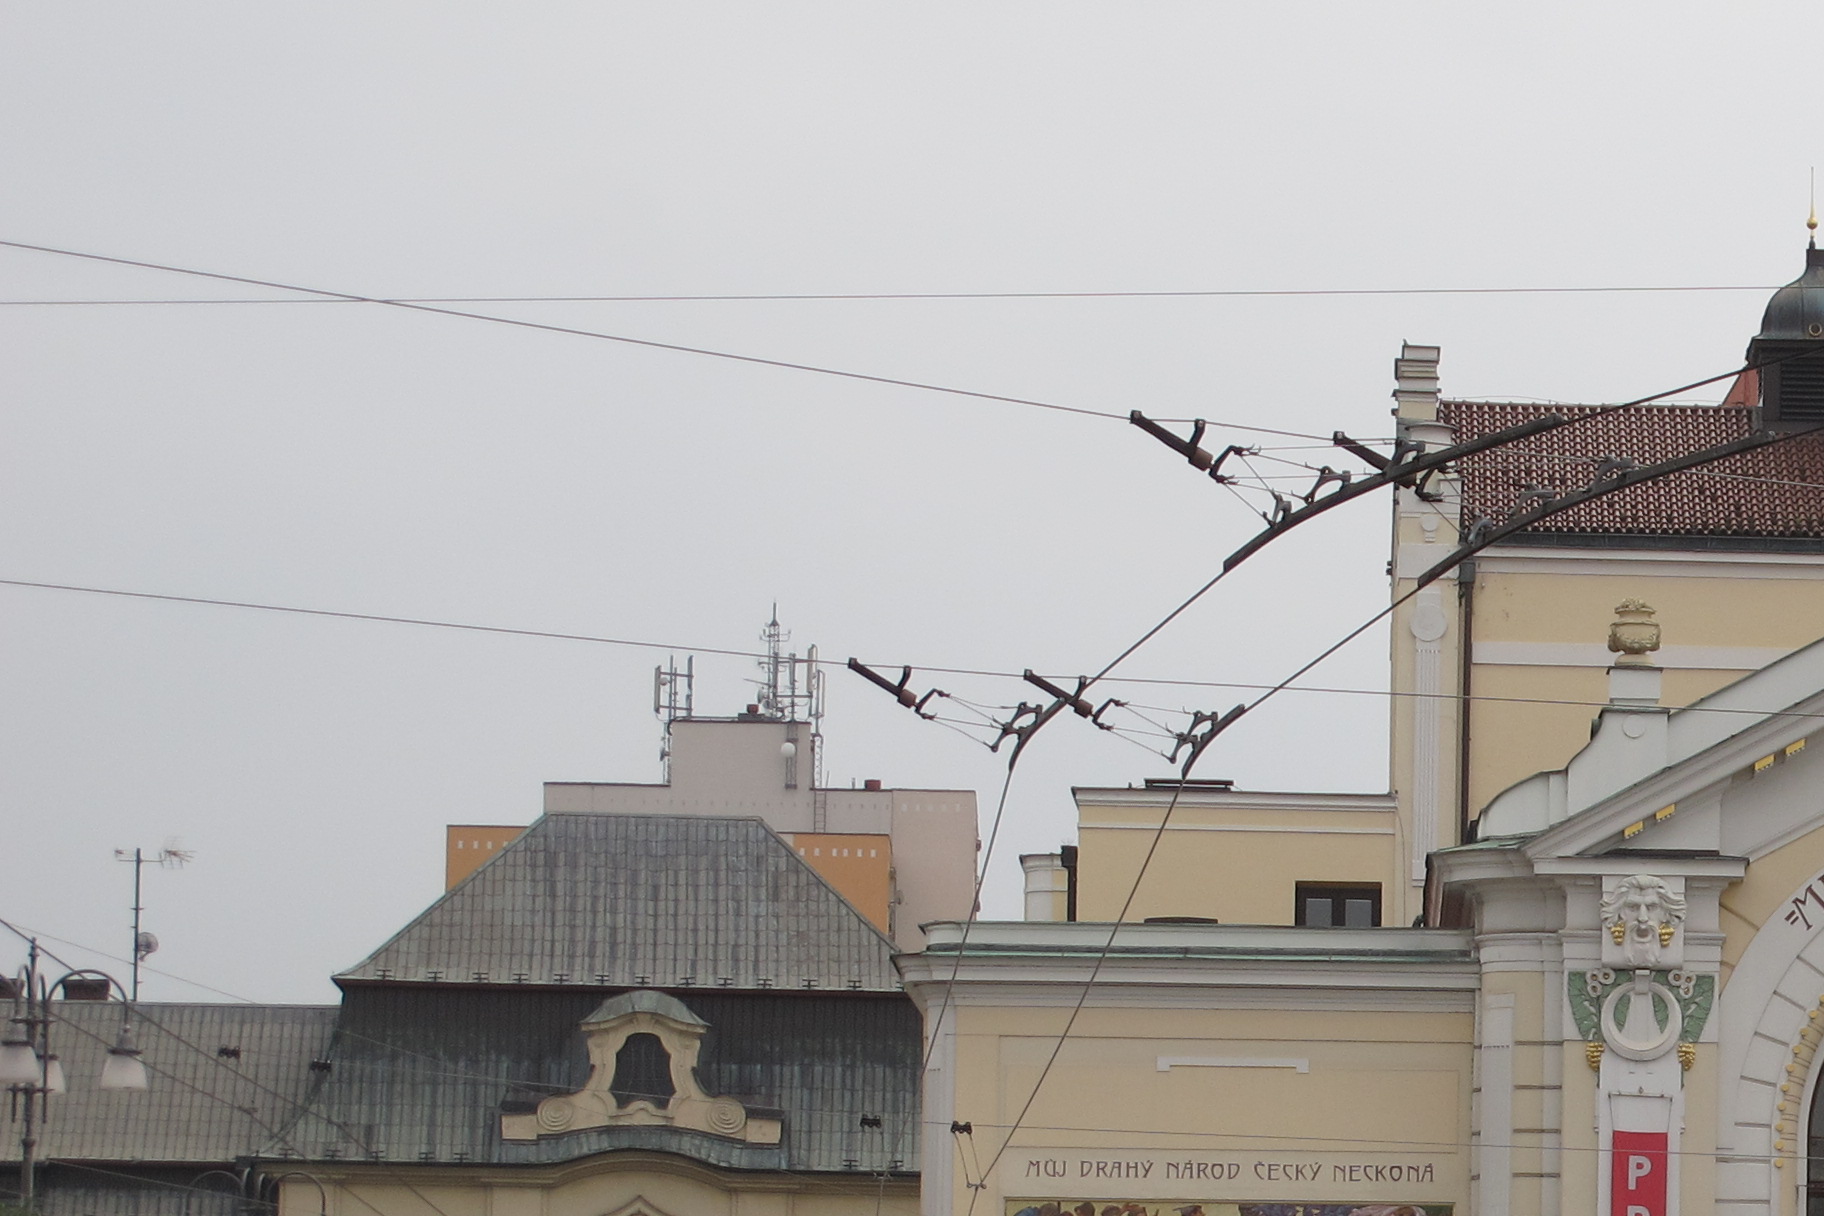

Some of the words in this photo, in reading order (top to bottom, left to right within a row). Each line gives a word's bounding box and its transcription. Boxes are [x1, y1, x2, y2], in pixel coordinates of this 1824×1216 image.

[1025, 1158, 1067, 1178] MŮJ
[1080, 1159, 1154, 1180] DRAHÝ
[1166, 1159, 1241, 1180] NÁROD
